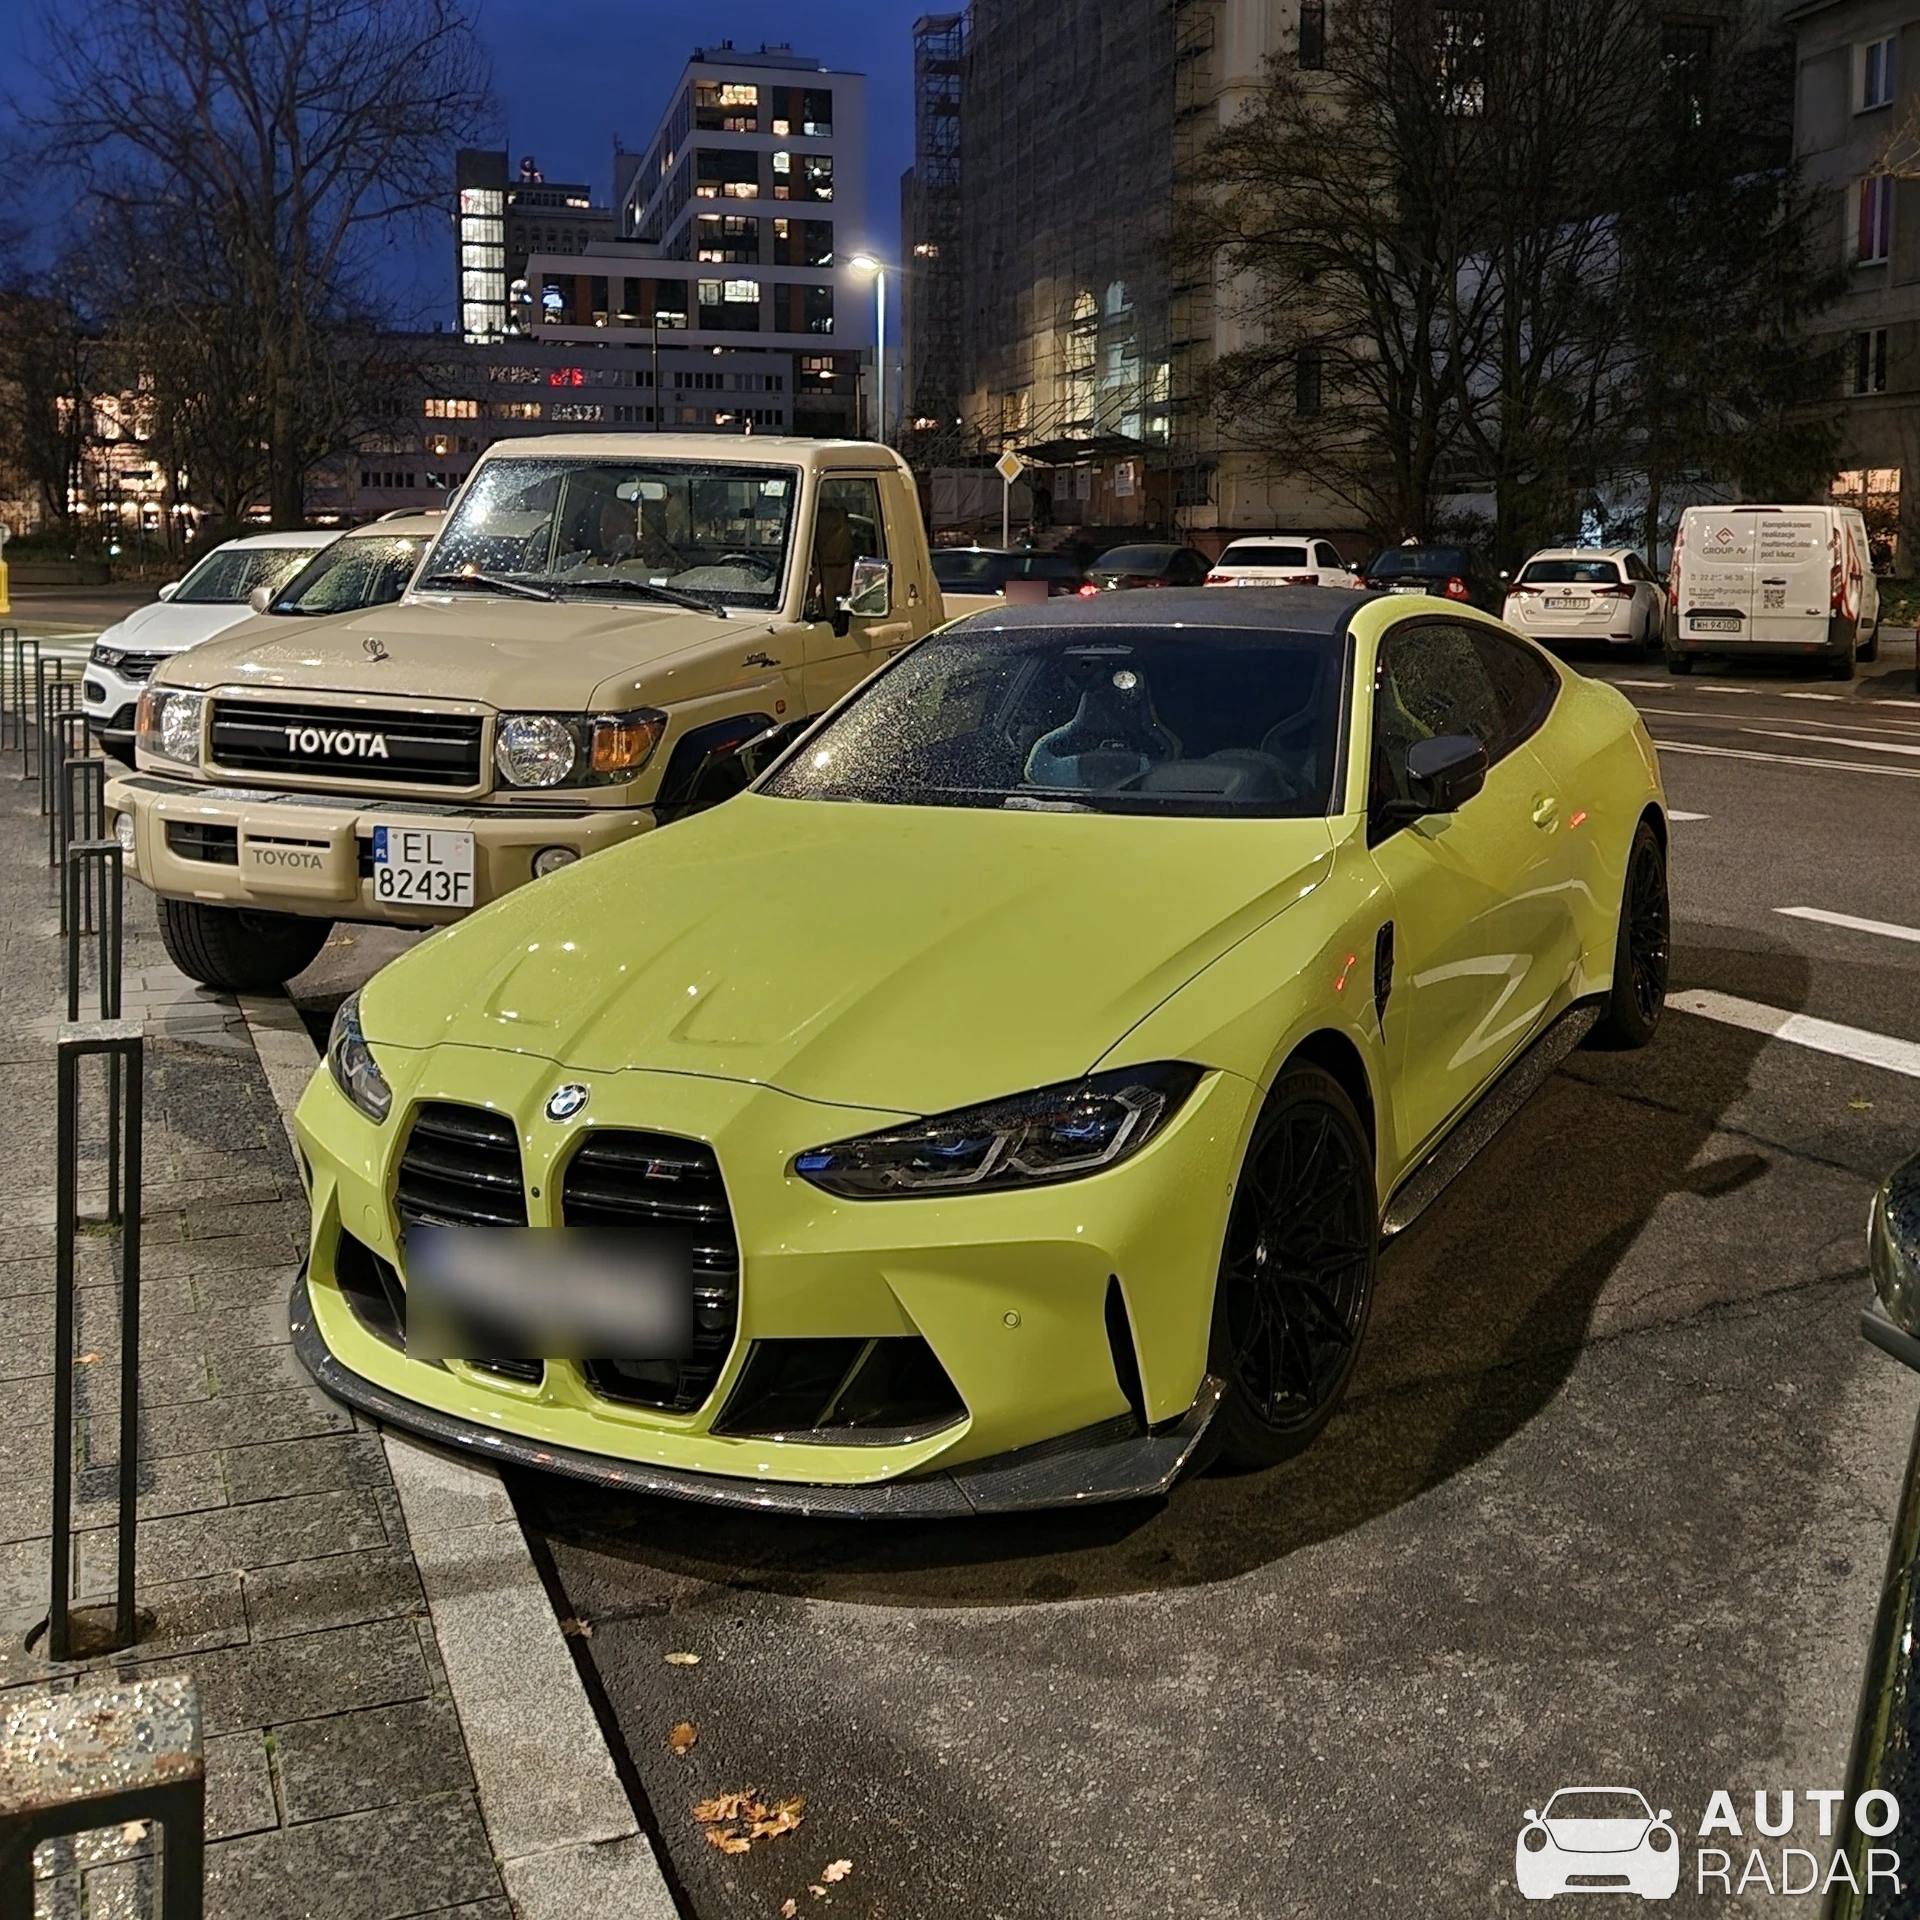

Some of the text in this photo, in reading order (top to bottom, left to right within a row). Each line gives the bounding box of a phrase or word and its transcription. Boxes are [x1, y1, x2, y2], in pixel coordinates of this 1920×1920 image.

[1762, 531, 1796, 539] realizacje
[1702, 546, 1734, 555] GROUP
[1761, 550, 1796, 559] pod klucz
[284, 728, 389, 758] TOYOTA
[375, 848, 387, 858] PL
[403, 833, 443, 865] EL
[253, 850, 323, 869] TOYOTA
[379, 867, 471, 903] 8243F
